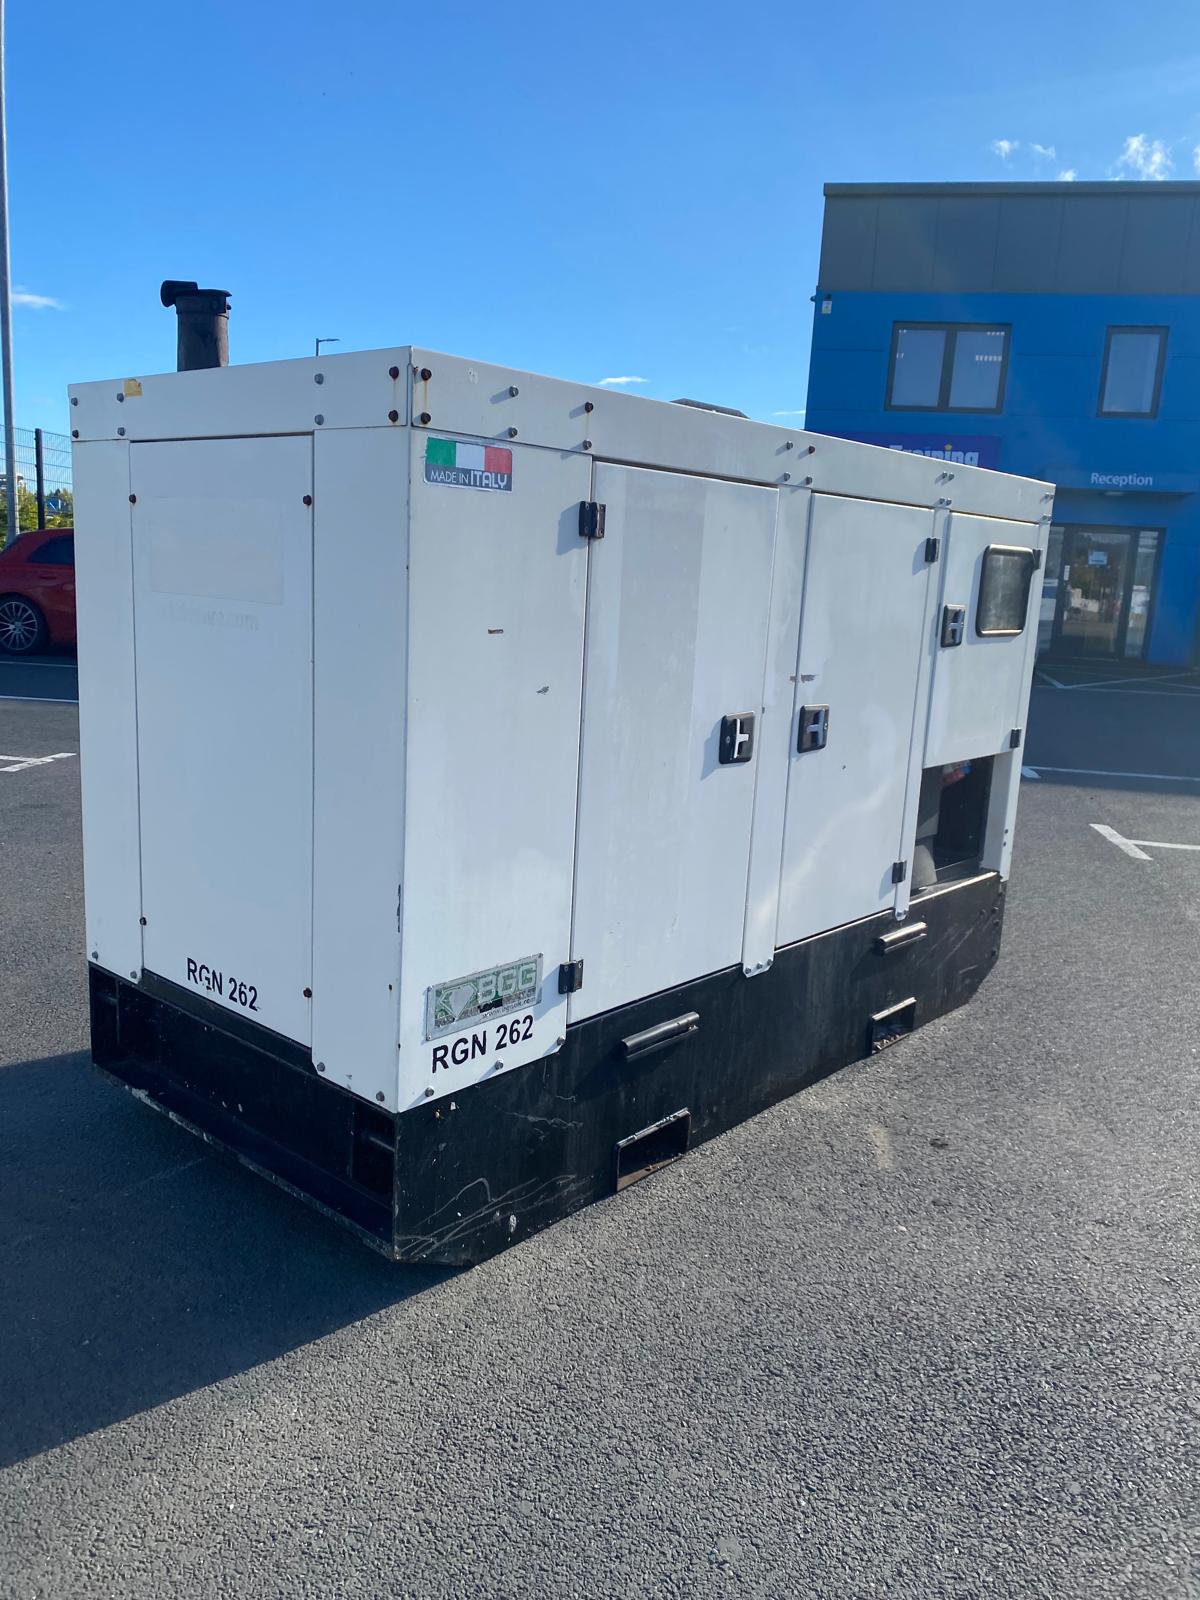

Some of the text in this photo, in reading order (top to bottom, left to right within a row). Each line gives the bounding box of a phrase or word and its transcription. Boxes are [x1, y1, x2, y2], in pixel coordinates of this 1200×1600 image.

[889, 444, 979, 466] ining
[430, 469, 507, 489] MADE IN ITALY
[1090, 472, 1153, 487] Reception
[187, 957, 259, 1012] RGN 262
[431, 1014, 534, 1074] RGN 262
